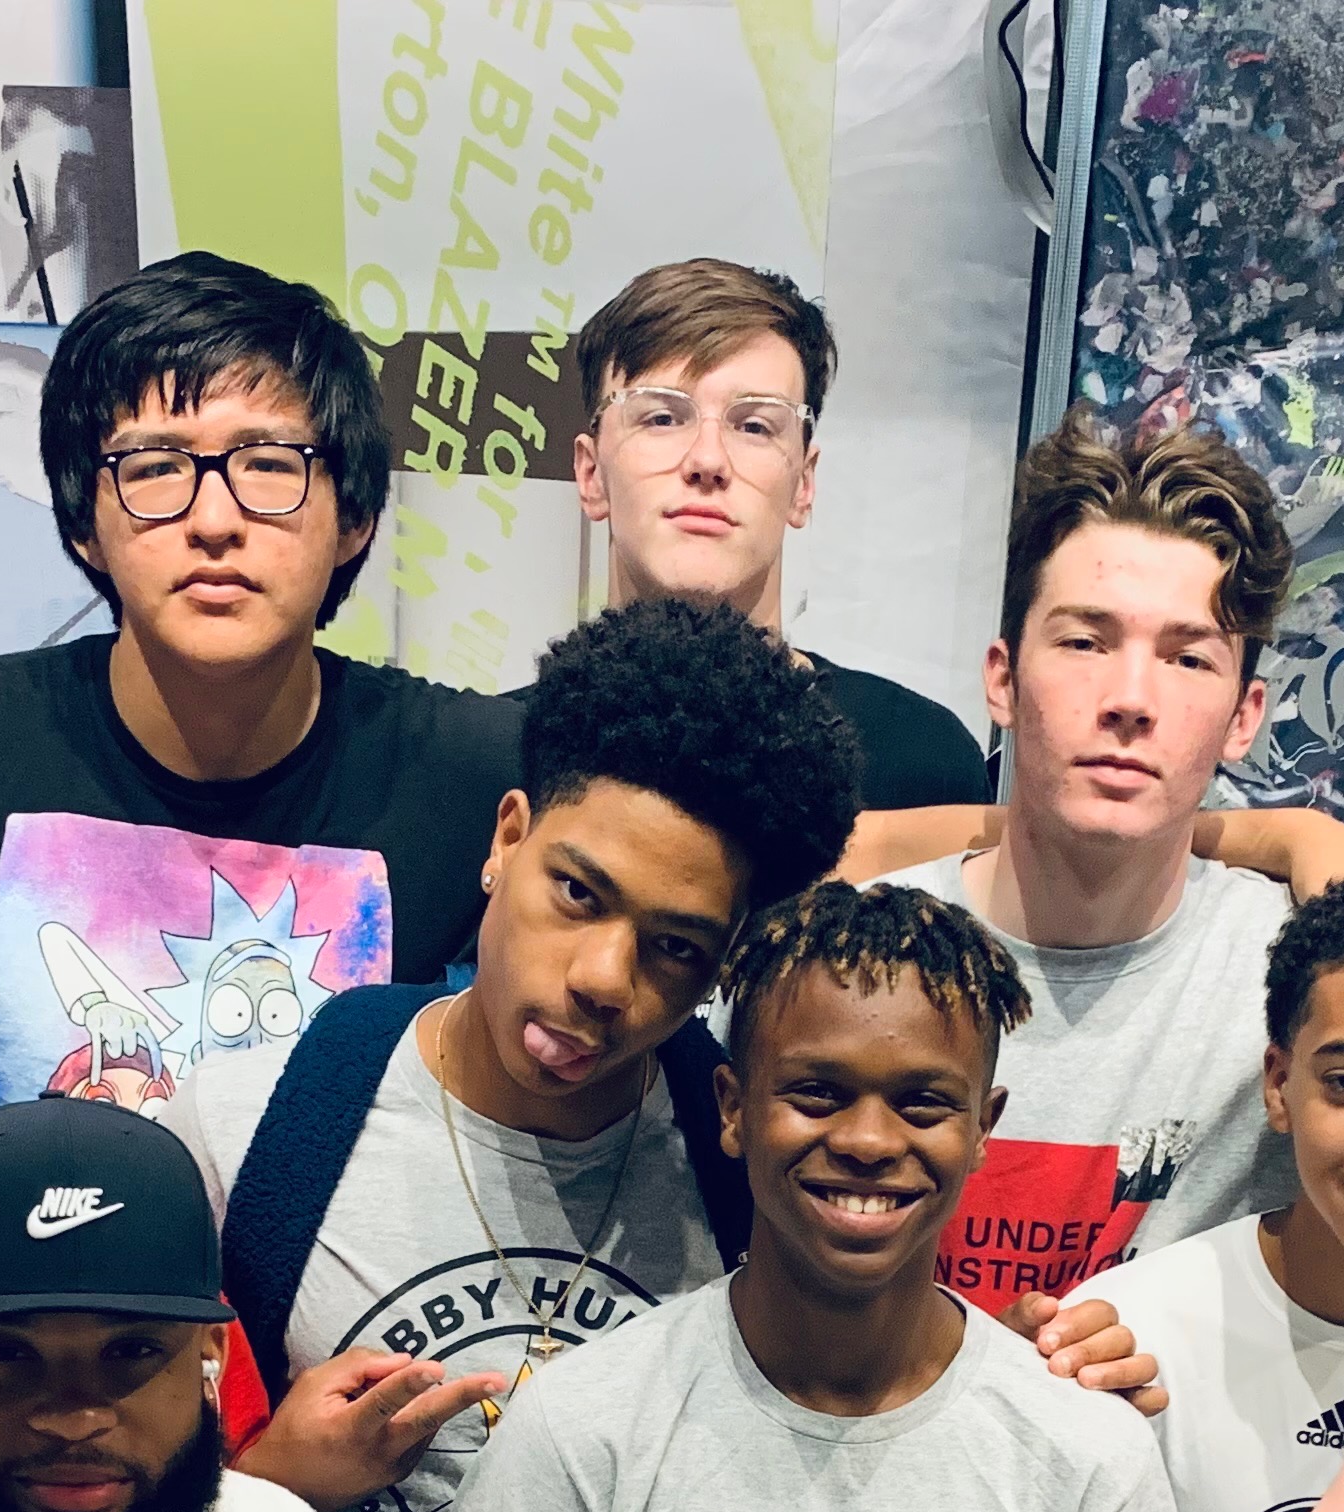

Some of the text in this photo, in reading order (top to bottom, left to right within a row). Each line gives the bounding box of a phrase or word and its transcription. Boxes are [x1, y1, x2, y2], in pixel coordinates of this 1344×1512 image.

[527, 0, 643, 267] White
[403, 58, 534, 492] BLAZER
[526, 287, 577, 382] TM
[475, 389, 548, 540] for
[38, 1186, 104, 1219] NIKE
